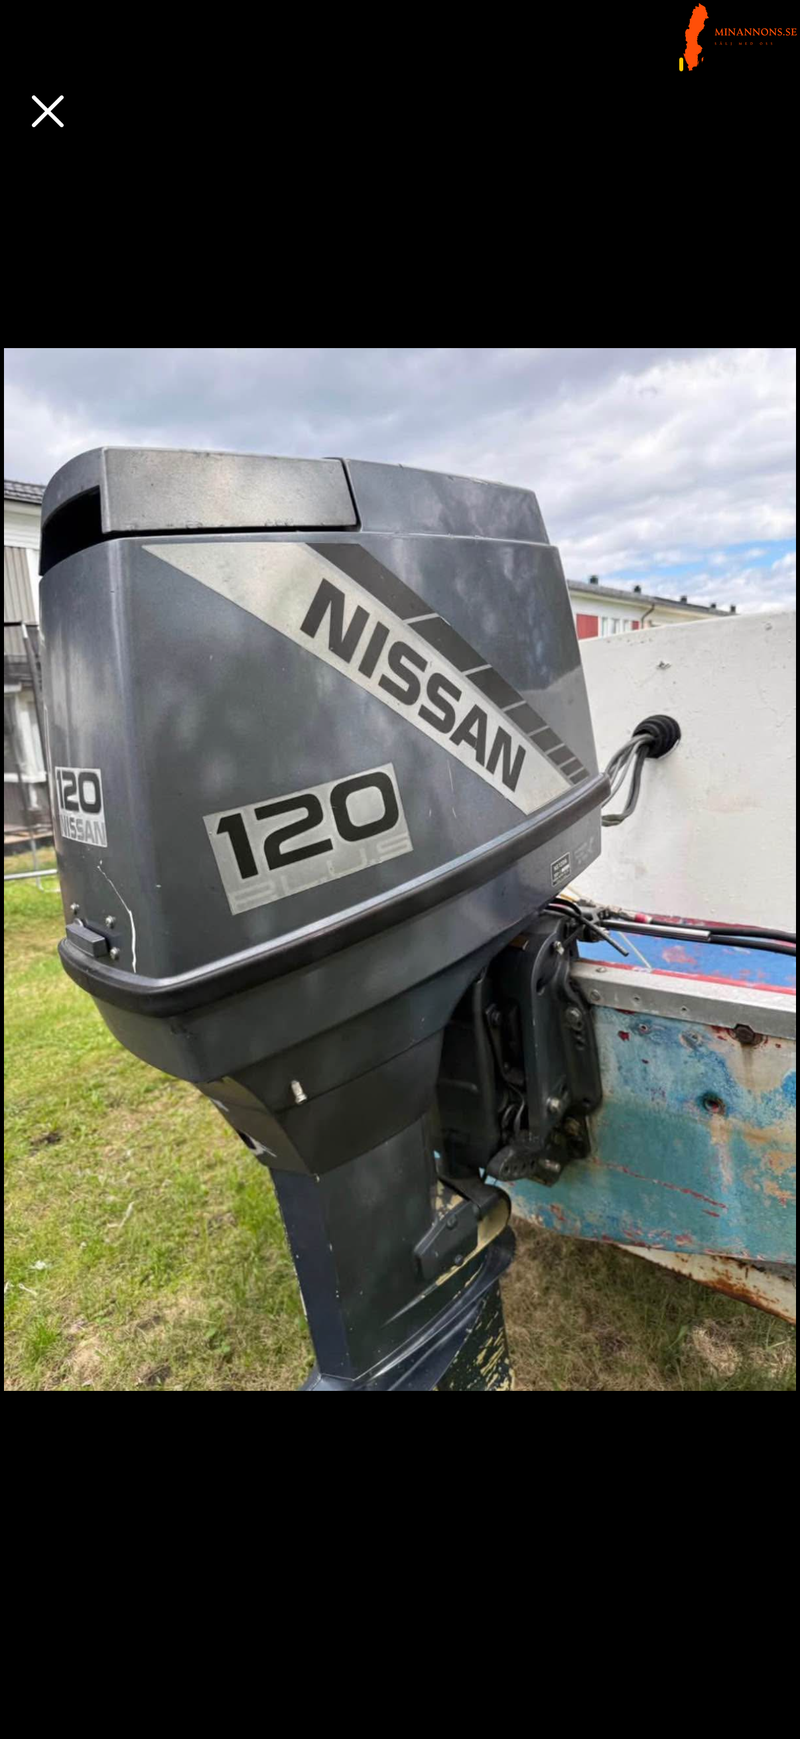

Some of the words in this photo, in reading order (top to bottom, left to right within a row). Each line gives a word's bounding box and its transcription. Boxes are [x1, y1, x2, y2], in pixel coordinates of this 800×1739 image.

[300, 578, 526, 792] NISSAN
[57, 770, 102, 814] 120
[61, 814, 106, 846] NISSAN
[216, 771, 400, 880] 120
